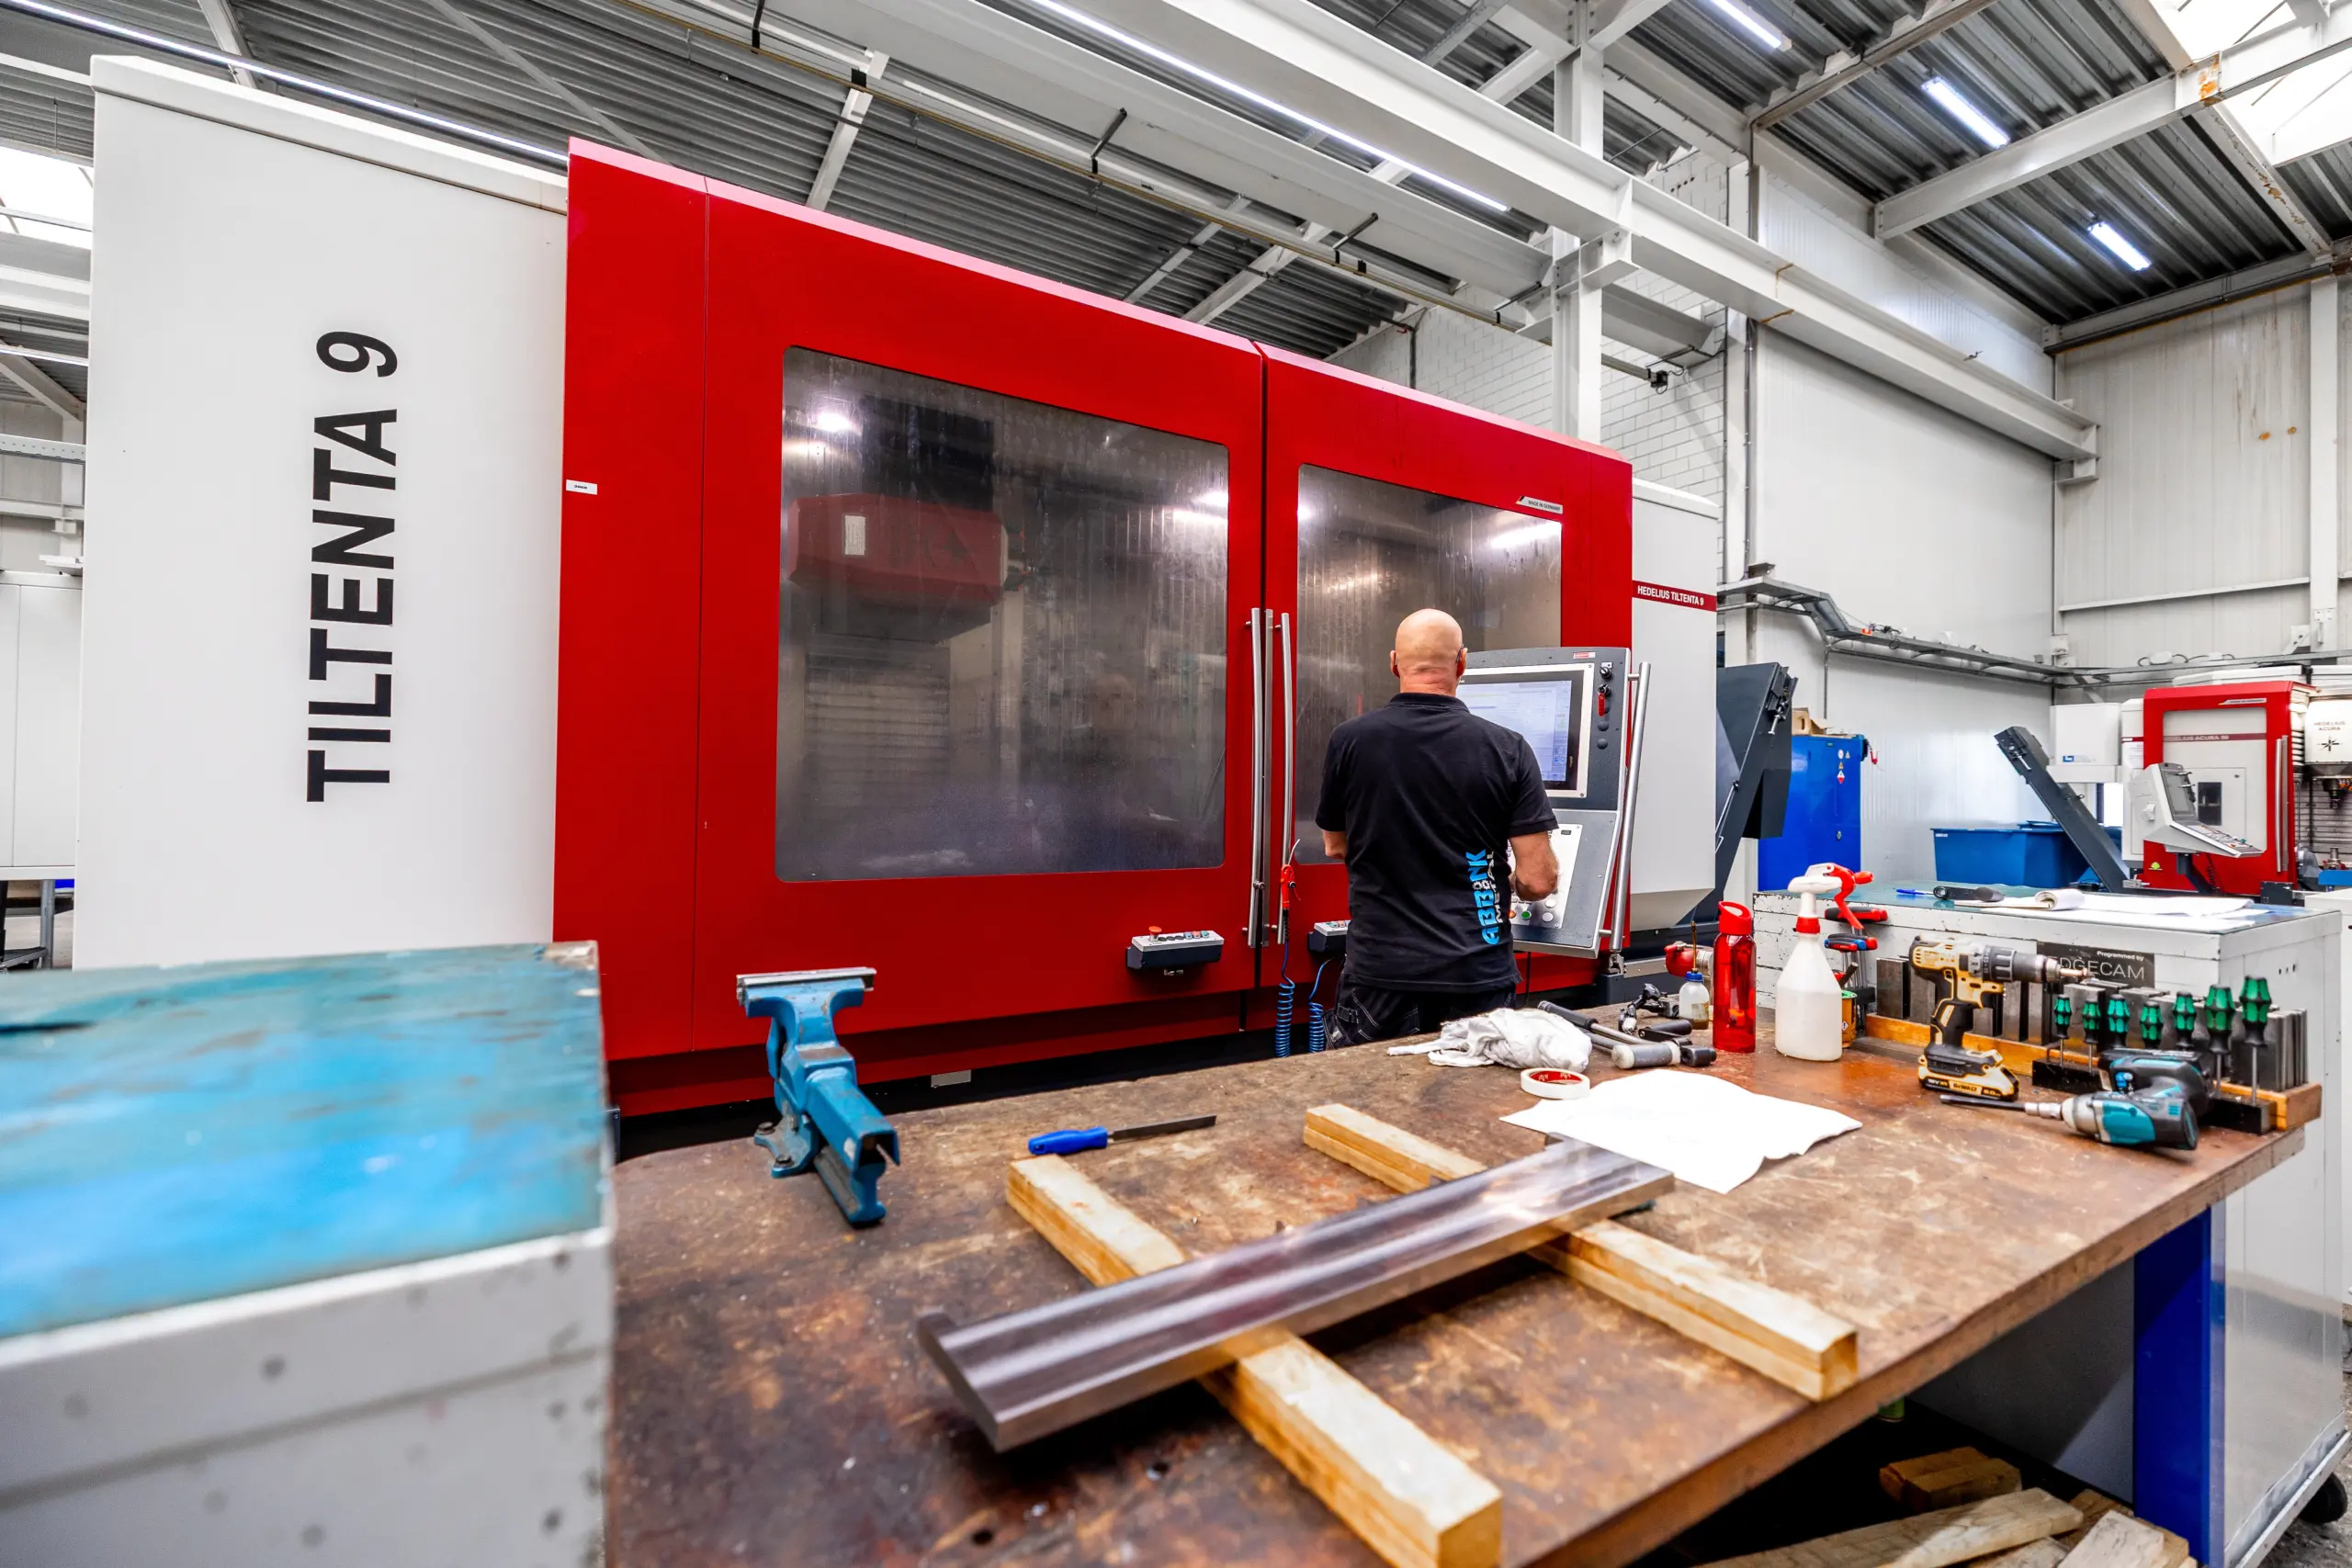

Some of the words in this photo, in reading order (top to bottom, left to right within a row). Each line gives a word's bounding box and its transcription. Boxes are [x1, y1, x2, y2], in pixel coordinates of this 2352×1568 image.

[316, 331, 398, 378] 9
[307, 409, 397, 802] TILTENTA
[1637, 585, 1670, 600] HEDELIUS
[1670, 591, 1700, 605] TILTENTA
[1700, 597, 1704, 605] 9
[2097, 950, 2135, 960] Programmed
[2048, 956, 2145, 980] DGECAM
